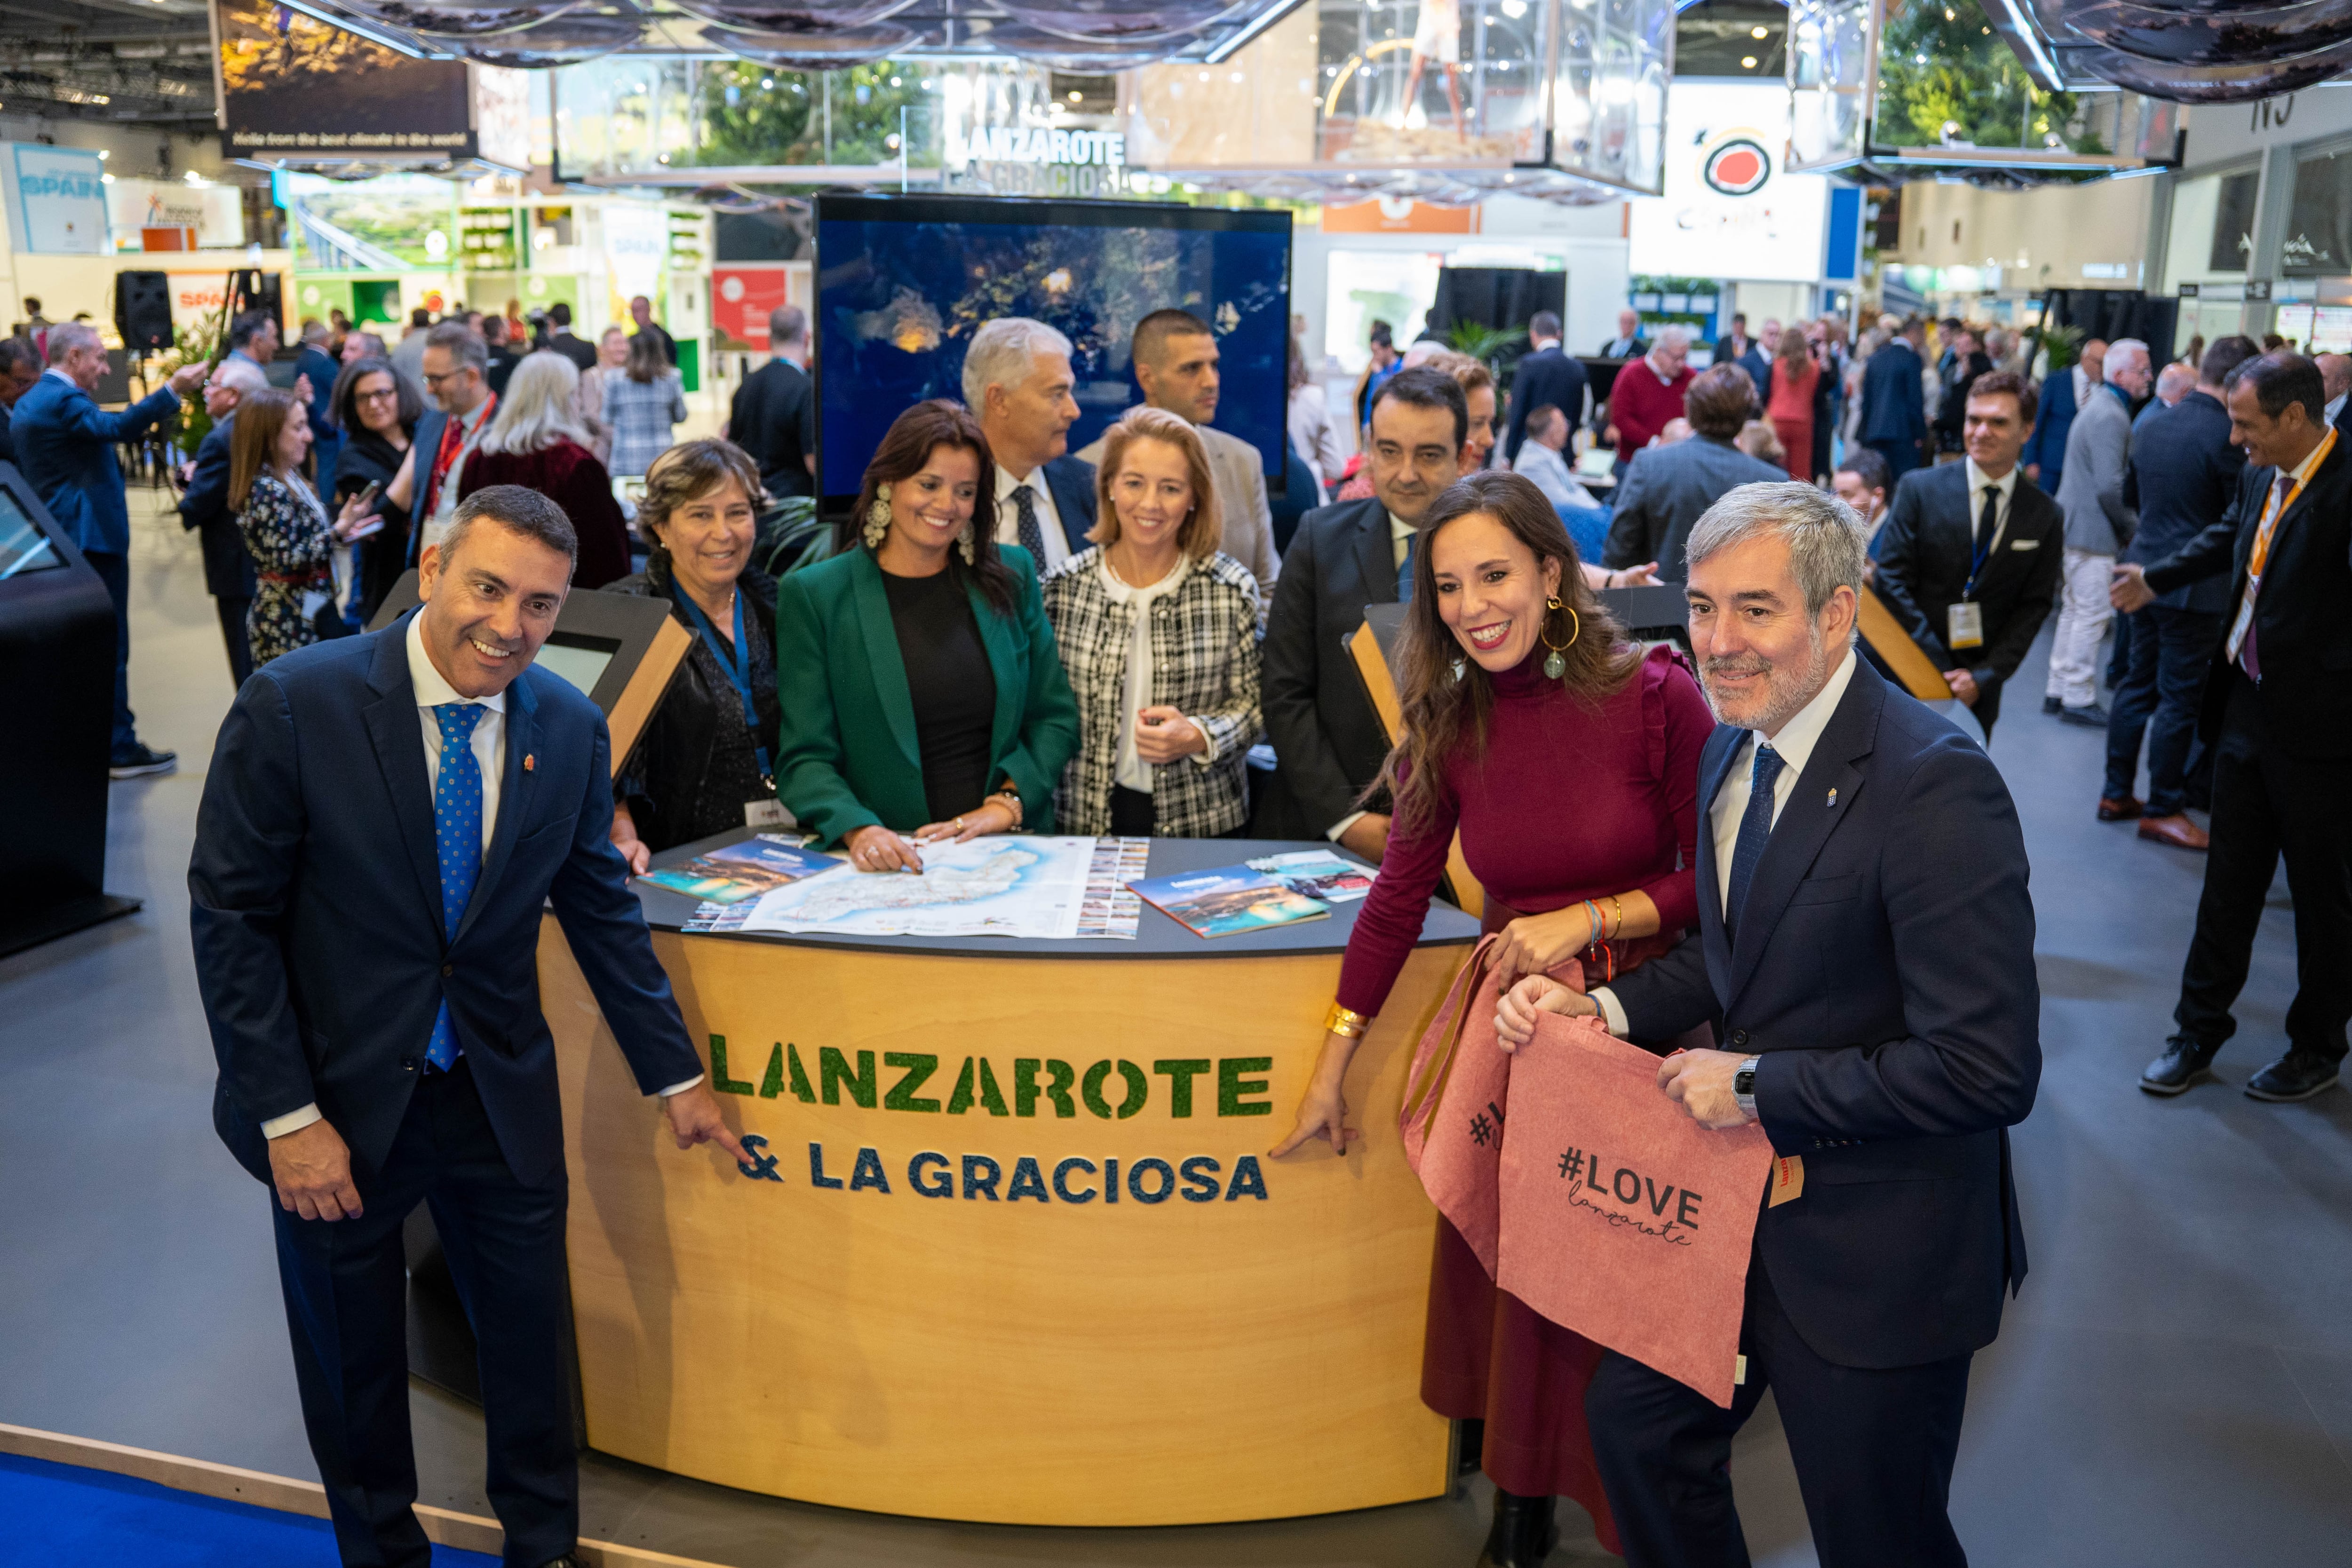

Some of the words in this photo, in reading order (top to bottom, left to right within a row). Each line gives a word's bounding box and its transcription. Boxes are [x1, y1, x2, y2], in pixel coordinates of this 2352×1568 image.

[232, 132, 265, 147] Hello
[266, 132, 295, 147] from
[297, 132, 319, 147] the
[319, 132, 347, 147] best
[348, 132, 393, 147] climate
[394, 132, 408, 147] in
[408, 132, 430, 147] the
[431, 132, 468, 147] world
[945, 125, 1125, 166] LANZAROTE
[991, 164, 1136, 198] GRACIOSA
[707, 1033, 1273, 1120] LANZAROTE
[736, 1134, 784, 1183] &
[809, 1142, 891, 1195] LA
[907, 1152, 1268, 1205] GRACIOSA
[1557, 1146, 1703, 1231] #LOVE
[1780, 1158, 1788, 1187] Lanza
[1568, 1178, 1693, 1248] lanzarote
